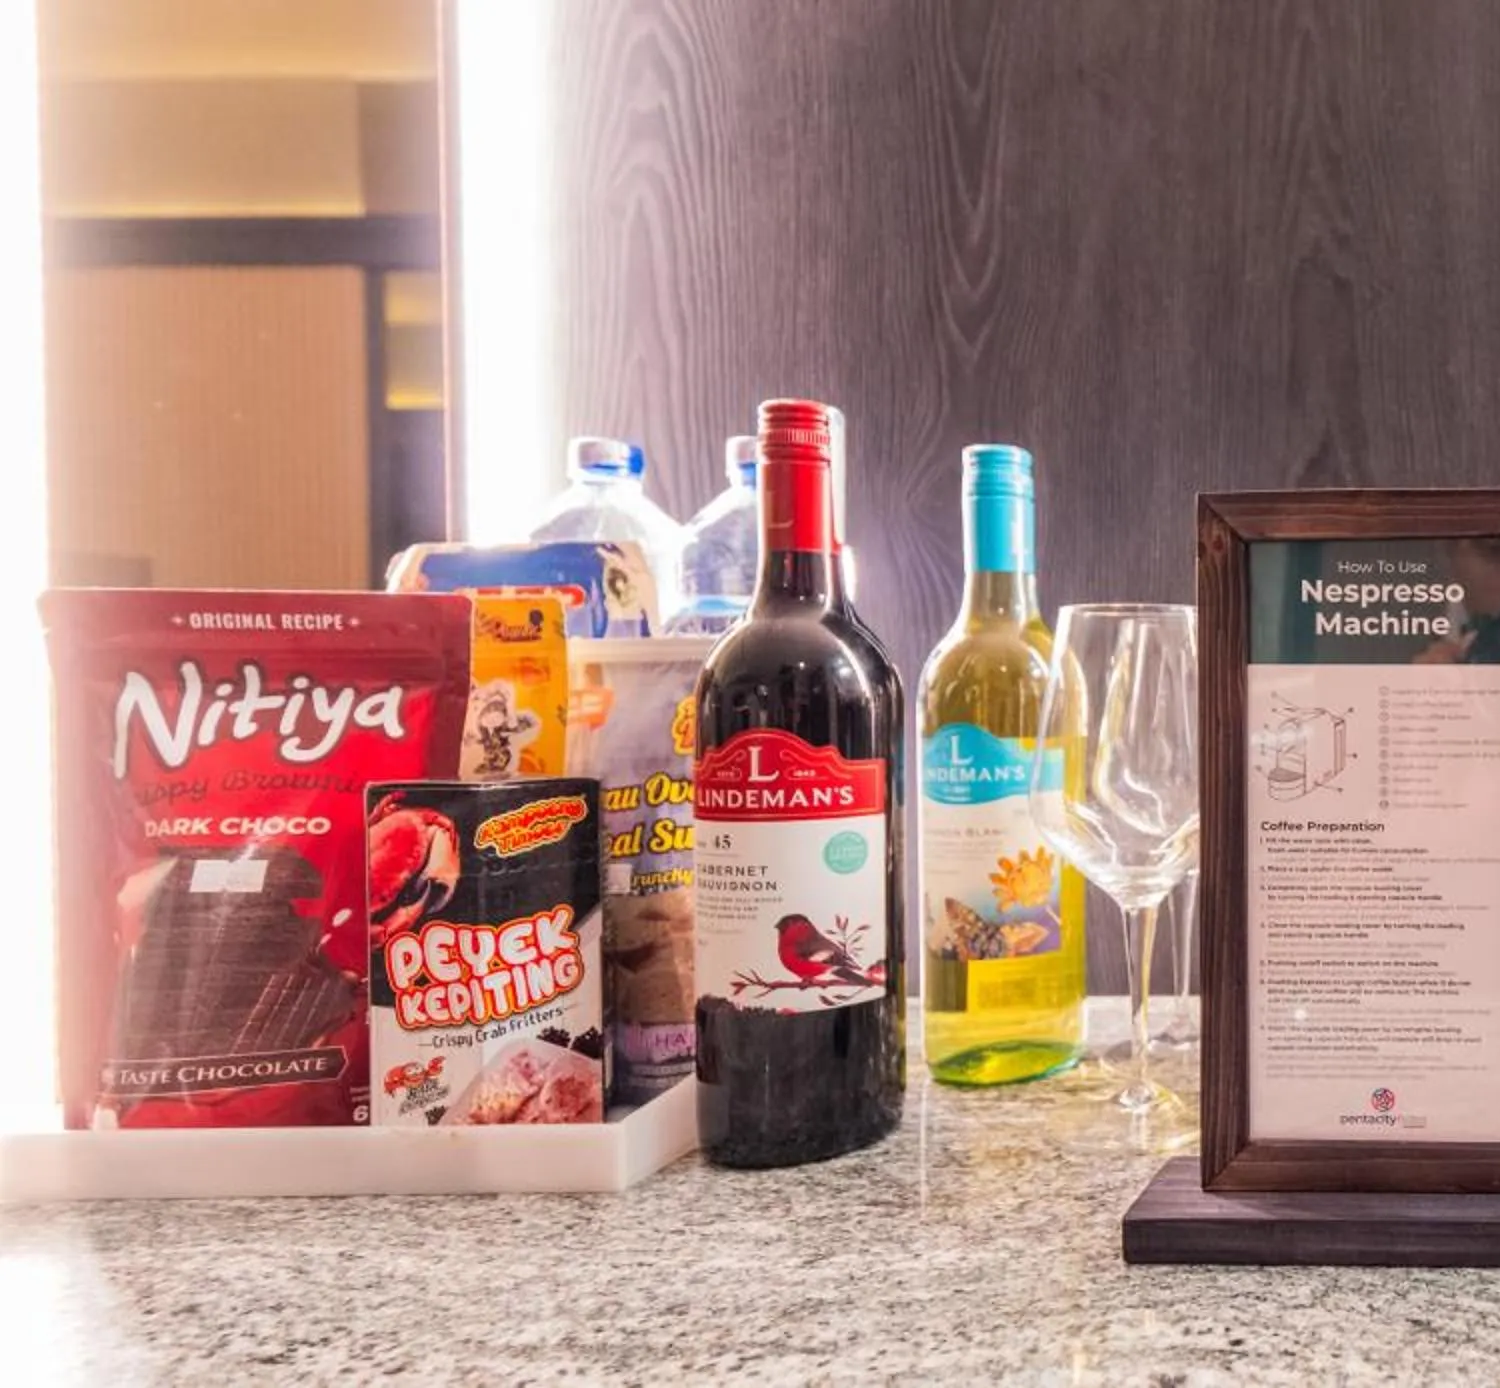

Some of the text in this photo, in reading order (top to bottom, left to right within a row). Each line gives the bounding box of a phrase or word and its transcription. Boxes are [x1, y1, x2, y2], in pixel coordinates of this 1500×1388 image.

[1338, 561, 1427, 573] How To Use
[1301, 579, 1465, 607] Nespresso
[189, 612, 345, 630] ORIGINAL RECIPE
[1315, 609, 1451, 636] Machine
[113, 661, 408, 779] Nitiya
[747, 745, 780, 782] L
[950, 735, 974, 766] L
[145, 815, 332, 838] DARK CHOCO
[1261, 821, 1385, 834] Coffee Preparation
[390, 909, 577, 990] PEYEK
[399, 953, 580, 1025] KEPITING
[432, 1033, 473, 1049] Crispy
[475, 1024, 507, 1041] Crab
[119, 1056, 329, 1086] TASTE CHOCOLATE
